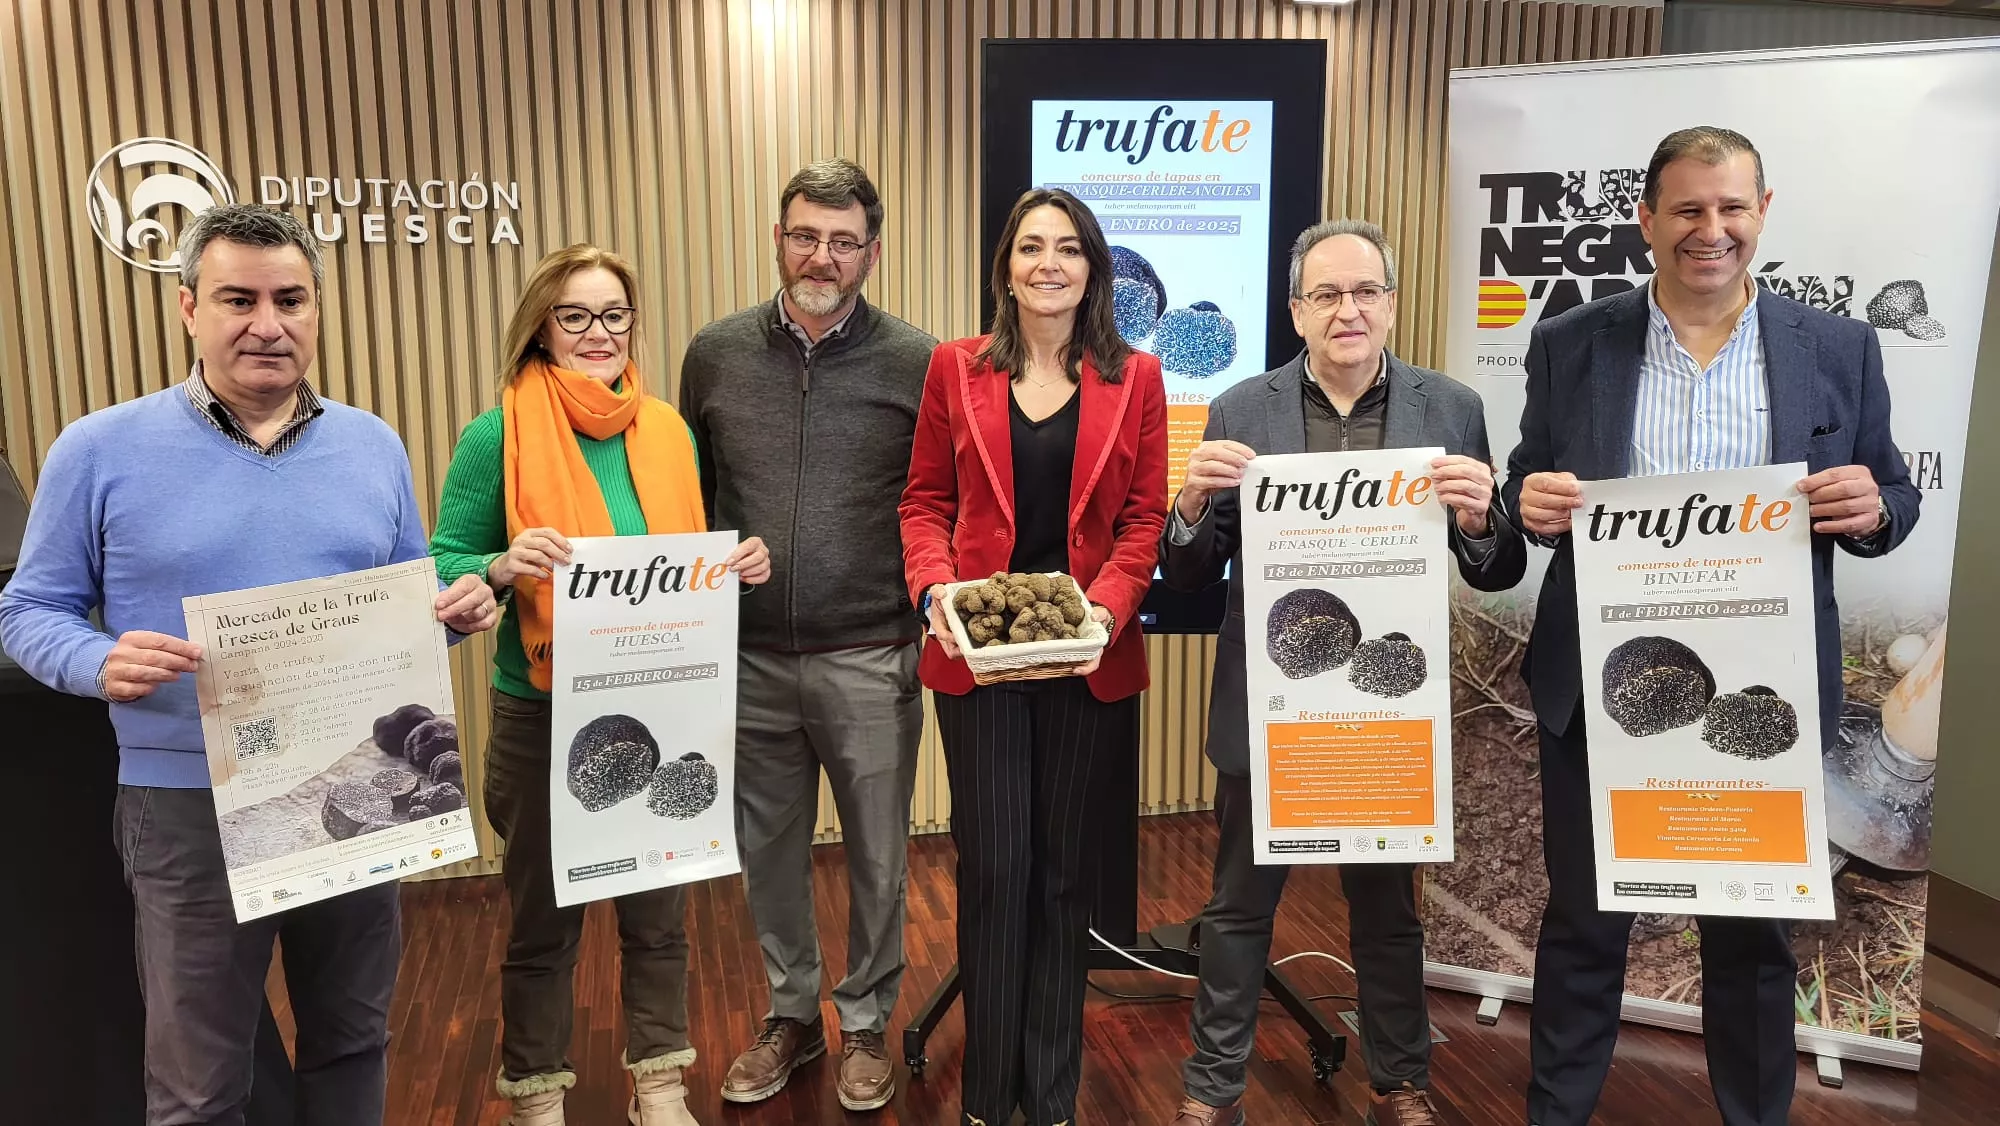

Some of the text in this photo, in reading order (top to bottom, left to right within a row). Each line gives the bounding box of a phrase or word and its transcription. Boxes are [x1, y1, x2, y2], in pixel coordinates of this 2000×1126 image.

[1056, 105, 1252, 165] trufate
[1081, 172, 1221, 184] concurso de tapas en
[260, 172, 520, 210] DIPUTACIÓN
[1480, 168, 1650, 224] TRUF
[313, 212, 520, 245] UESCA
[1110, 218, 1239, 234] ENERO de 2025
[1480, 224, 1657, 276] NEGR
[1256, 468, 1432, 520] trufate
[1280, 524, 1406, 536] concurso de tapas en
[1588, 493, 1792, 548] trufate
[1268, 538, 1348, 551] BENASQUE
[1361, 535, 1418, 547] CERLER
[1267, 562, 1424, 578] 18 de ENERO de 2025
[1617, 556, 1764, 572] concurso de tapas en
[568, 555, 728, 606] trufate
[1643, 570, 1737, 586] BINEFAR
[216, 588, 389, 629] Mercado de la Trufa
[1606, 602, 1784, 619] 1 de FEBRERO de 2025
[218, 614, 359, 648] Fresca de Graus
[590, 620, 704, 636] concurso de tapas en
[614, 632, 681, 648] HUESCA
[223, 654, 325, 679] Venta de trufa y
[305, 669, 318, 678] de
[323, 663, 354, 674] tapas
[358, 658, 378, 667] con
[382, 650, 411, 662] trufa
[576, 679, 592, 690] 15
[605, 670, 672, 686] FEBRERO
[684, 666, 717, 678] 2025
[1292, 710, 1406, 721] -Restaurantes-
[1640, 777, 1770, 789] -Restaurantes-
